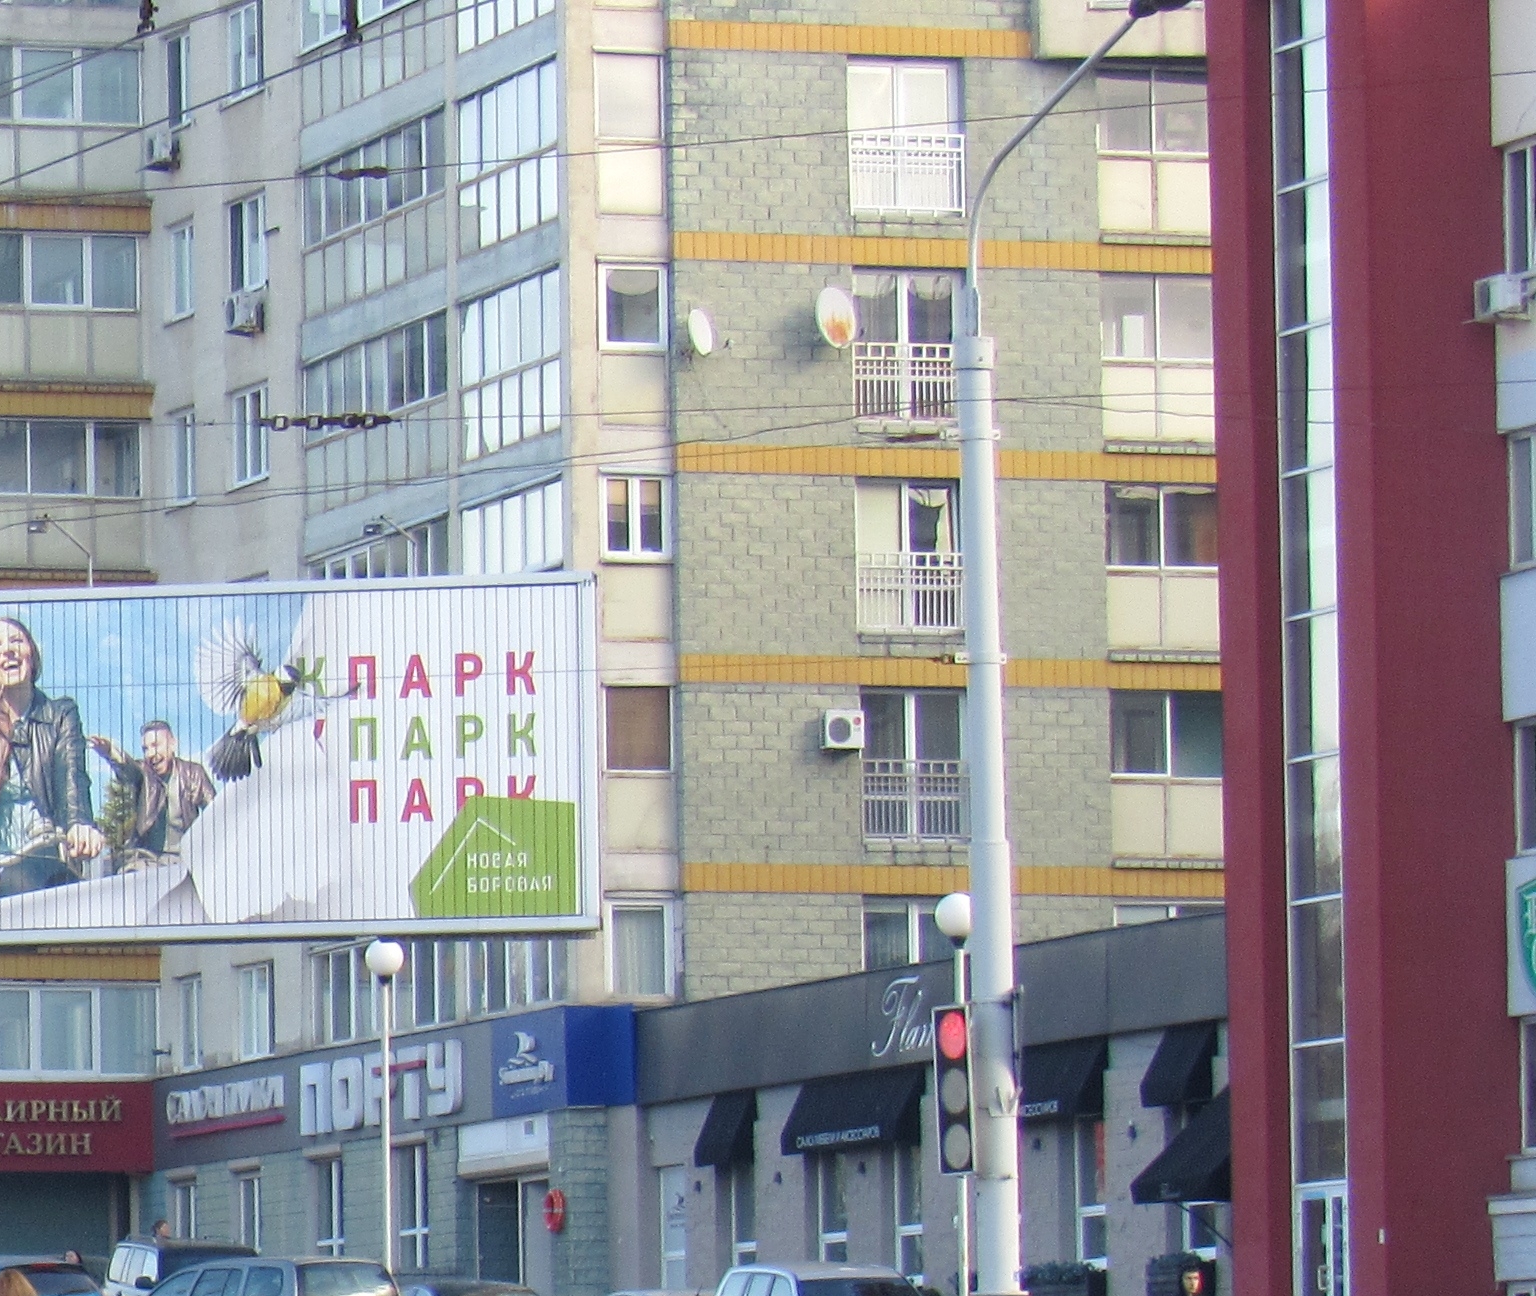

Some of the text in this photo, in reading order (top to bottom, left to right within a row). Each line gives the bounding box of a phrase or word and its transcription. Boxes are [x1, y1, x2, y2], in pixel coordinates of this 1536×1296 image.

[348, 651, 537, 700] ПАРК
[349, 712, 537, 762] ПАРК
[467, 852, 528, 870] НОВАЯ
[466, 875, 553, 894] БОРОВАЯ
